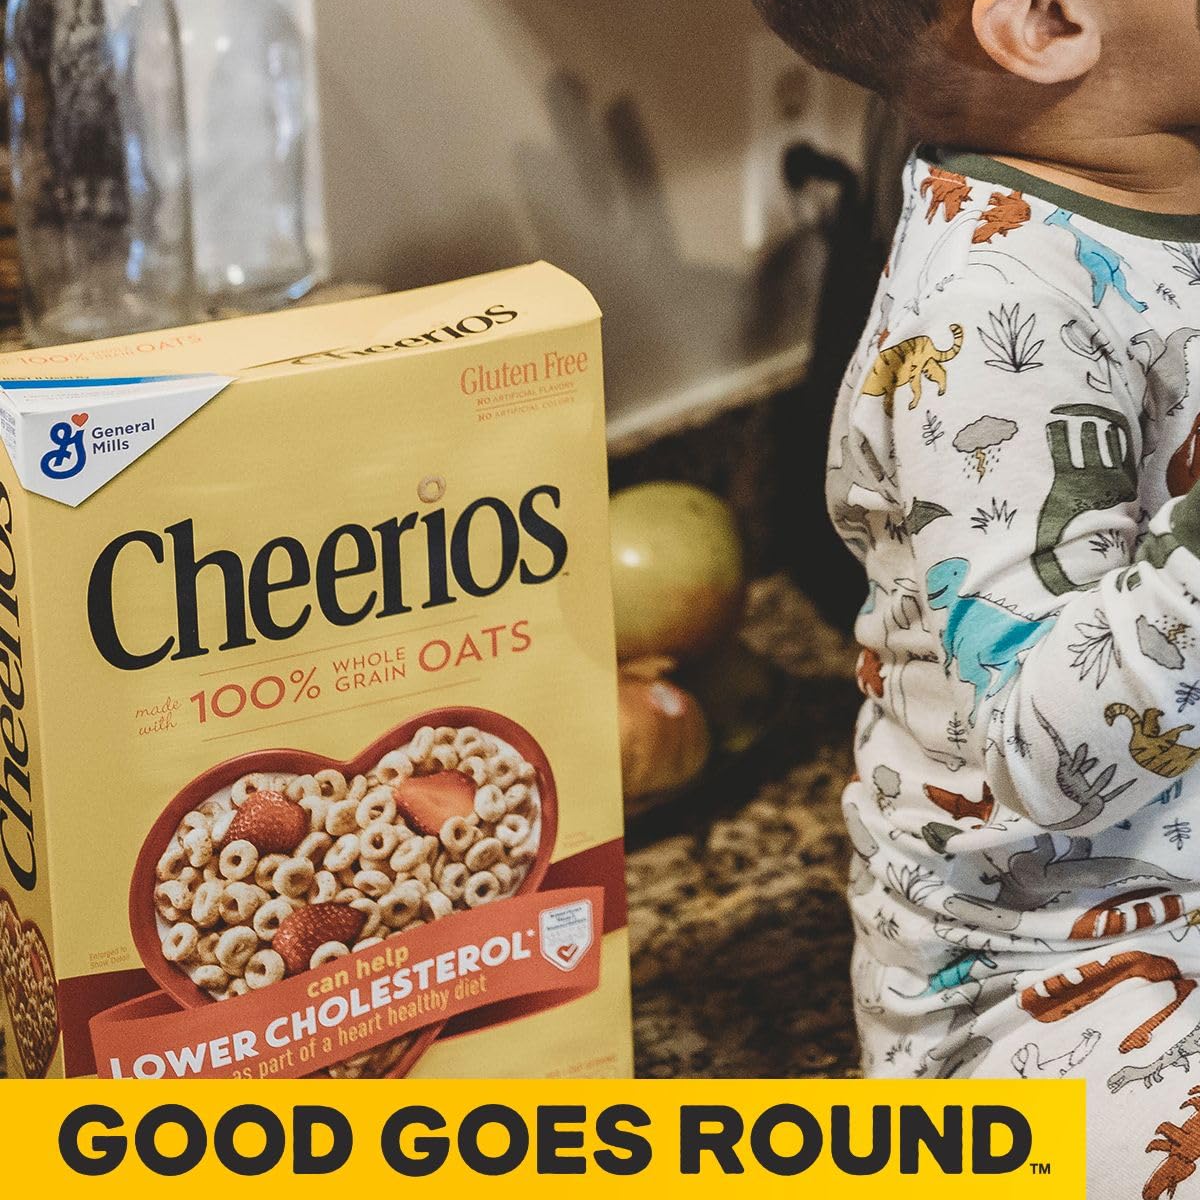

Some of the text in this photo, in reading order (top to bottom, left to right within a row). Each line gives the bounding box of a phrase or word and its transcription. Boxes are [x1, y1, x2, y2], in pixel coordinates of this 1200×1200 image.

[460, 351, 588, 396] Gluten Free
[91, 418, 155, 440] General
[93, 439, 129, 454] Mills
[87, 477, 568, 670] Cheerios
[190, 620, 533, 723] 100% OATS
[332, 647, 406, 674] WHOLE
[335, 663, 406, 692] GRAIN
[134, 697, 182, 720] made
[137, 717, 178, 737] with
[307, 945, 409, 998] can help
[258, 1048, 294, 1079] part
[300, 1037, 317, 1063] of
[322, 1036, 333, 1053] a
[338, 1014, 382, 1046] heart
[388, 989, 450, 1026] healthy
[454, 973, 487, 1000] diet
[110, 1030, 259, 1079] LOWER
